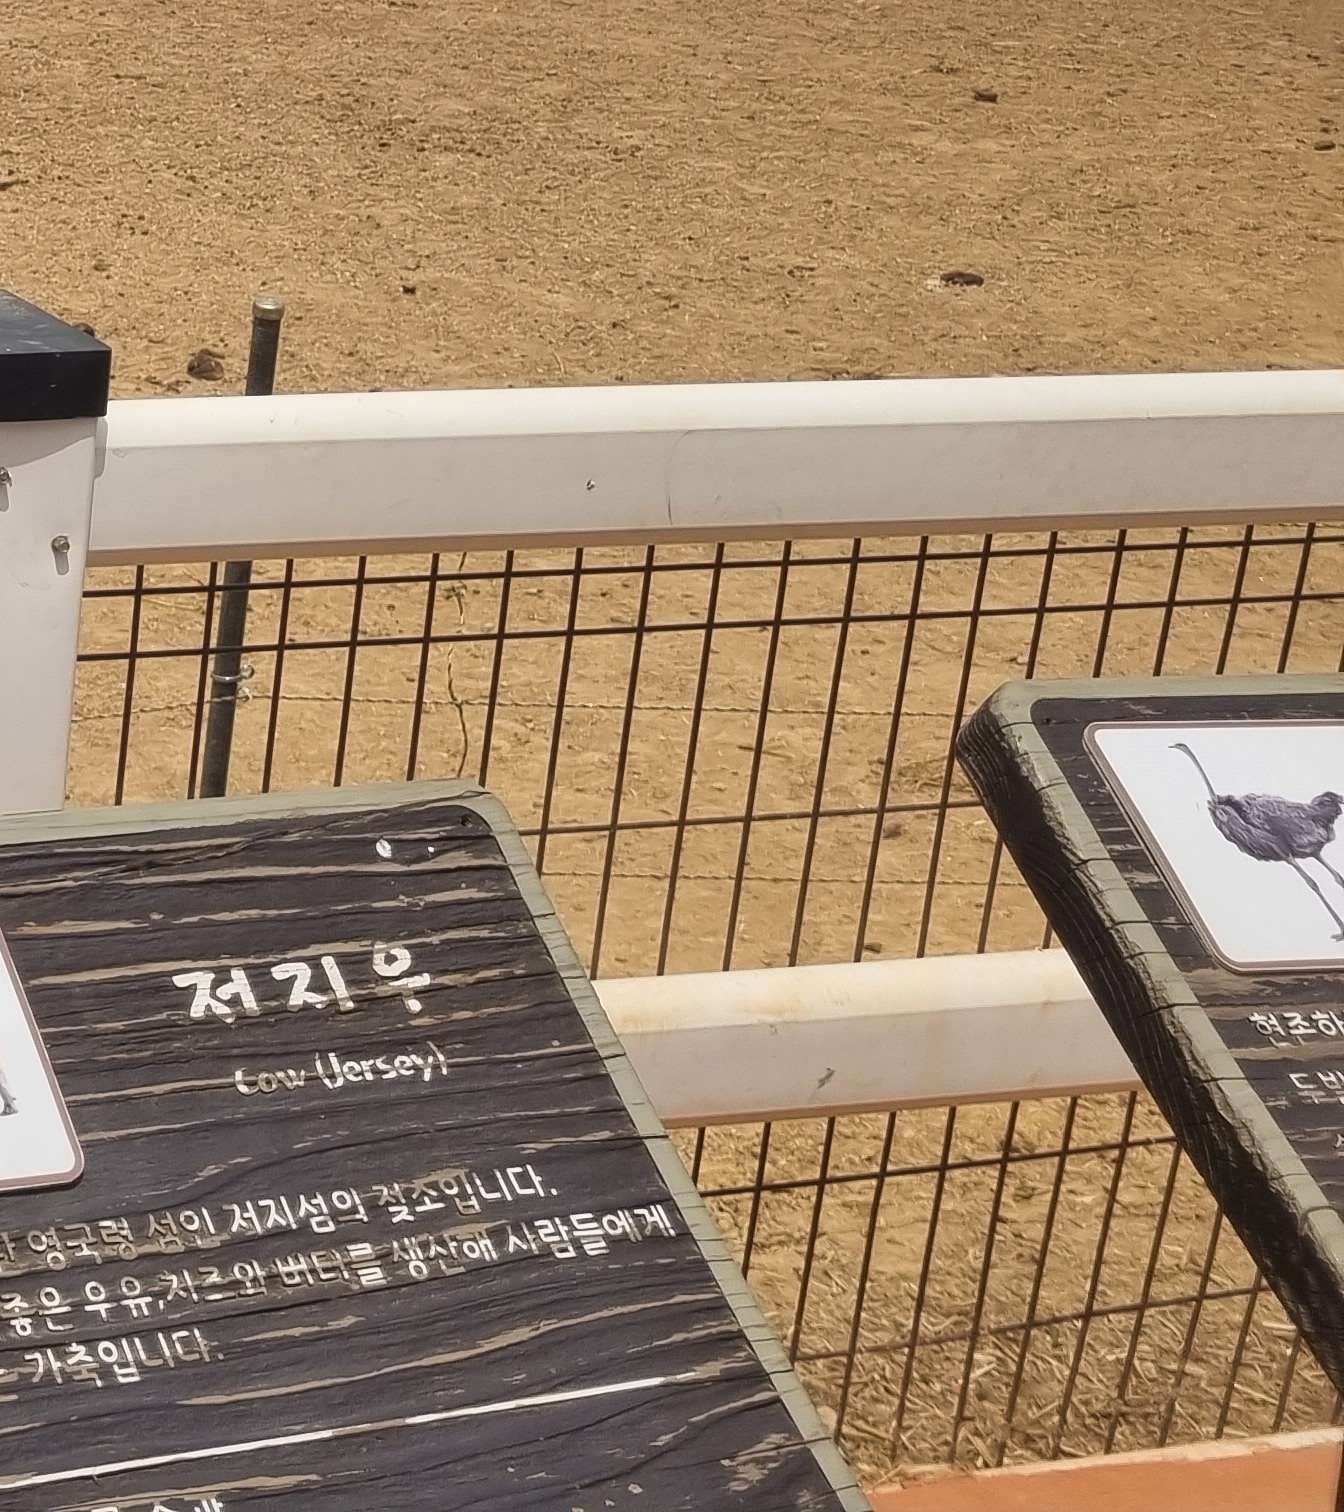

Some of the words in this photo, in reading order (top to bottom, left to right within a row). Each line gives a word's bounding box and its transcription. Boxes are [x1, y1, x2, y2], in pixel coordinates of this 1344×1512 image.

[171, 941, 432, 1024] 저지우
[27, 1216, 135, 1271] 영국령
[148, 1206, 216, 1251] 섬인
[222, 1187, 369, 1234] 저지섬의
[371, 1163, 559, 1225] 젖소입니다.
[0, 1286, 74, 1337] 좋은
[392, 1225, 499, 1281] 생산해
[507, 1203, 677, 1259] 사람들에게
[24, 1326, 225, 1389] 가축입니다.
